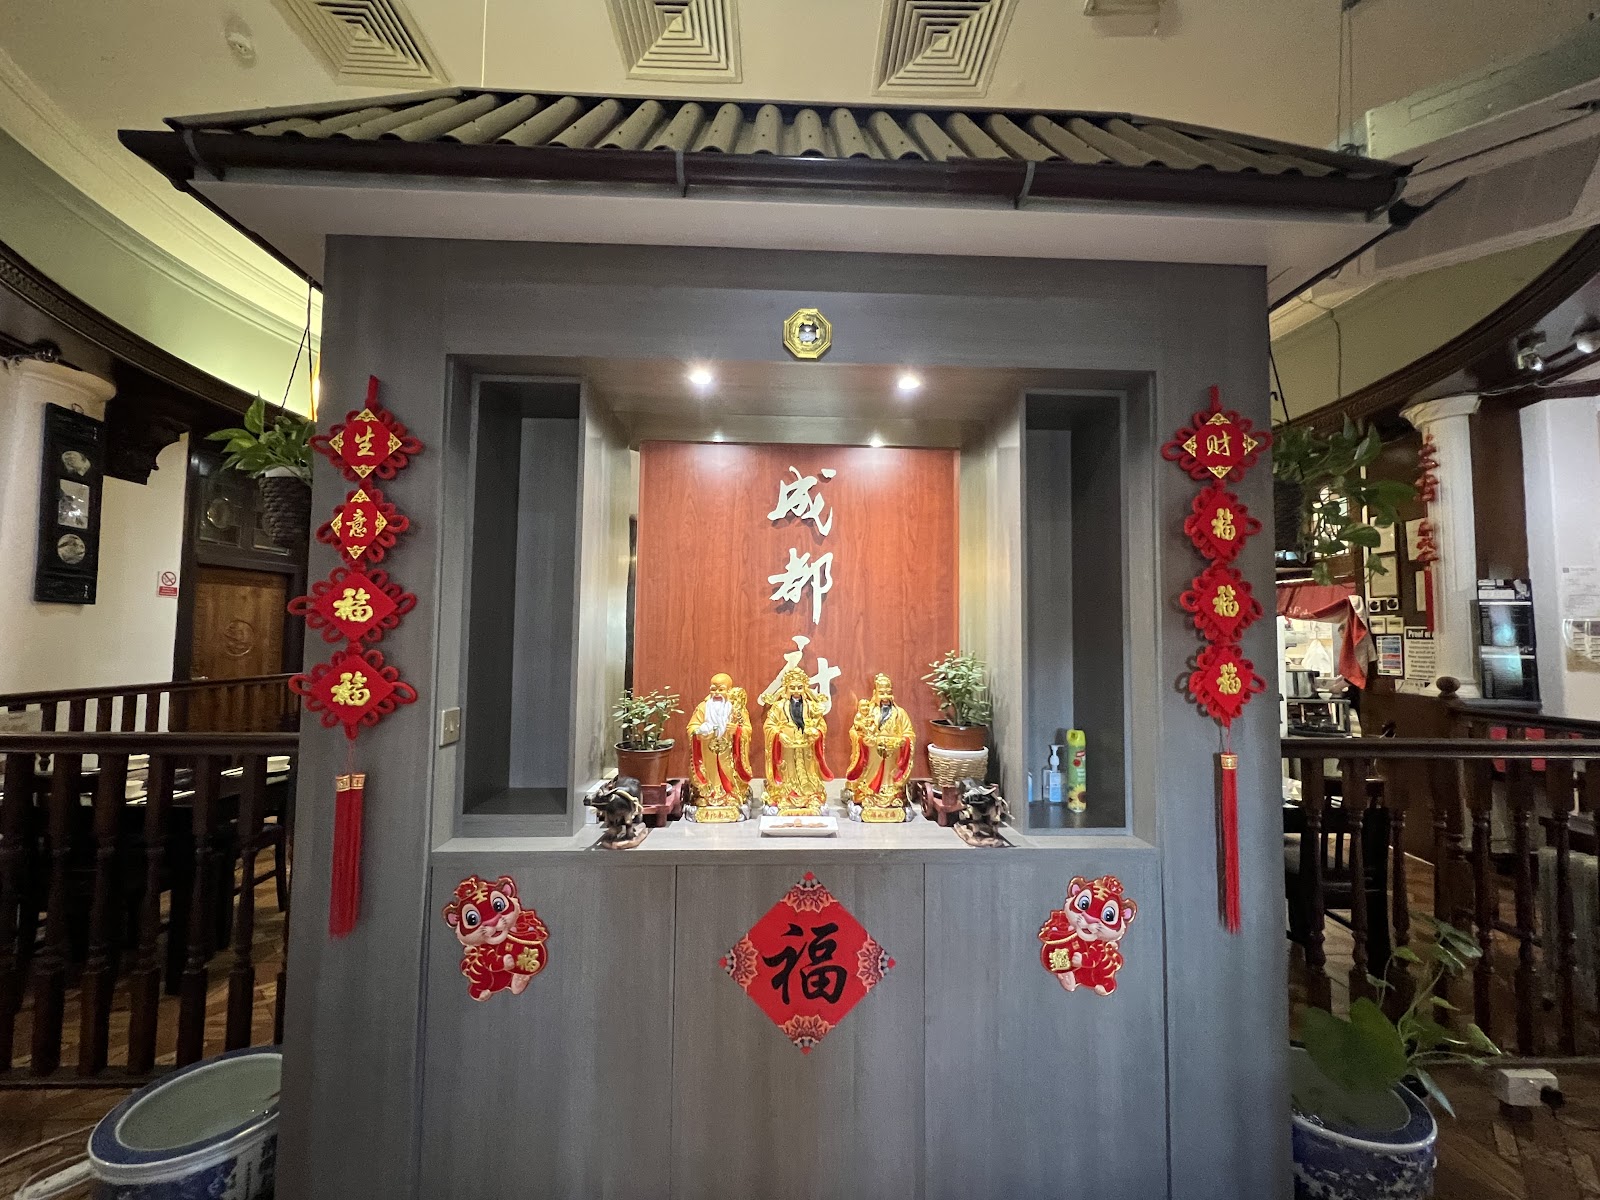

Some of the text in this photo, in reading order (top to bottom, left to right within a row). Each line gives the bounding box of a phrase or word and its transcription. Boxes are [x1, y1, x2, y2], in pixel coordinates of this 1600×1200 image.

[354, 425, 376, 456] 生
[1206, 430, 1231, 456] 财
[346, 508, 368, 538] 意
[1210, 507, 1236, 541] 福
[332, 587, 374, 623] 福
[1212, 584, 1240, 617] 福
[330, 670, 371, 706] 福
[1216, 662, 1242, 695] 福
[762, 922, 848, 1005] 福
